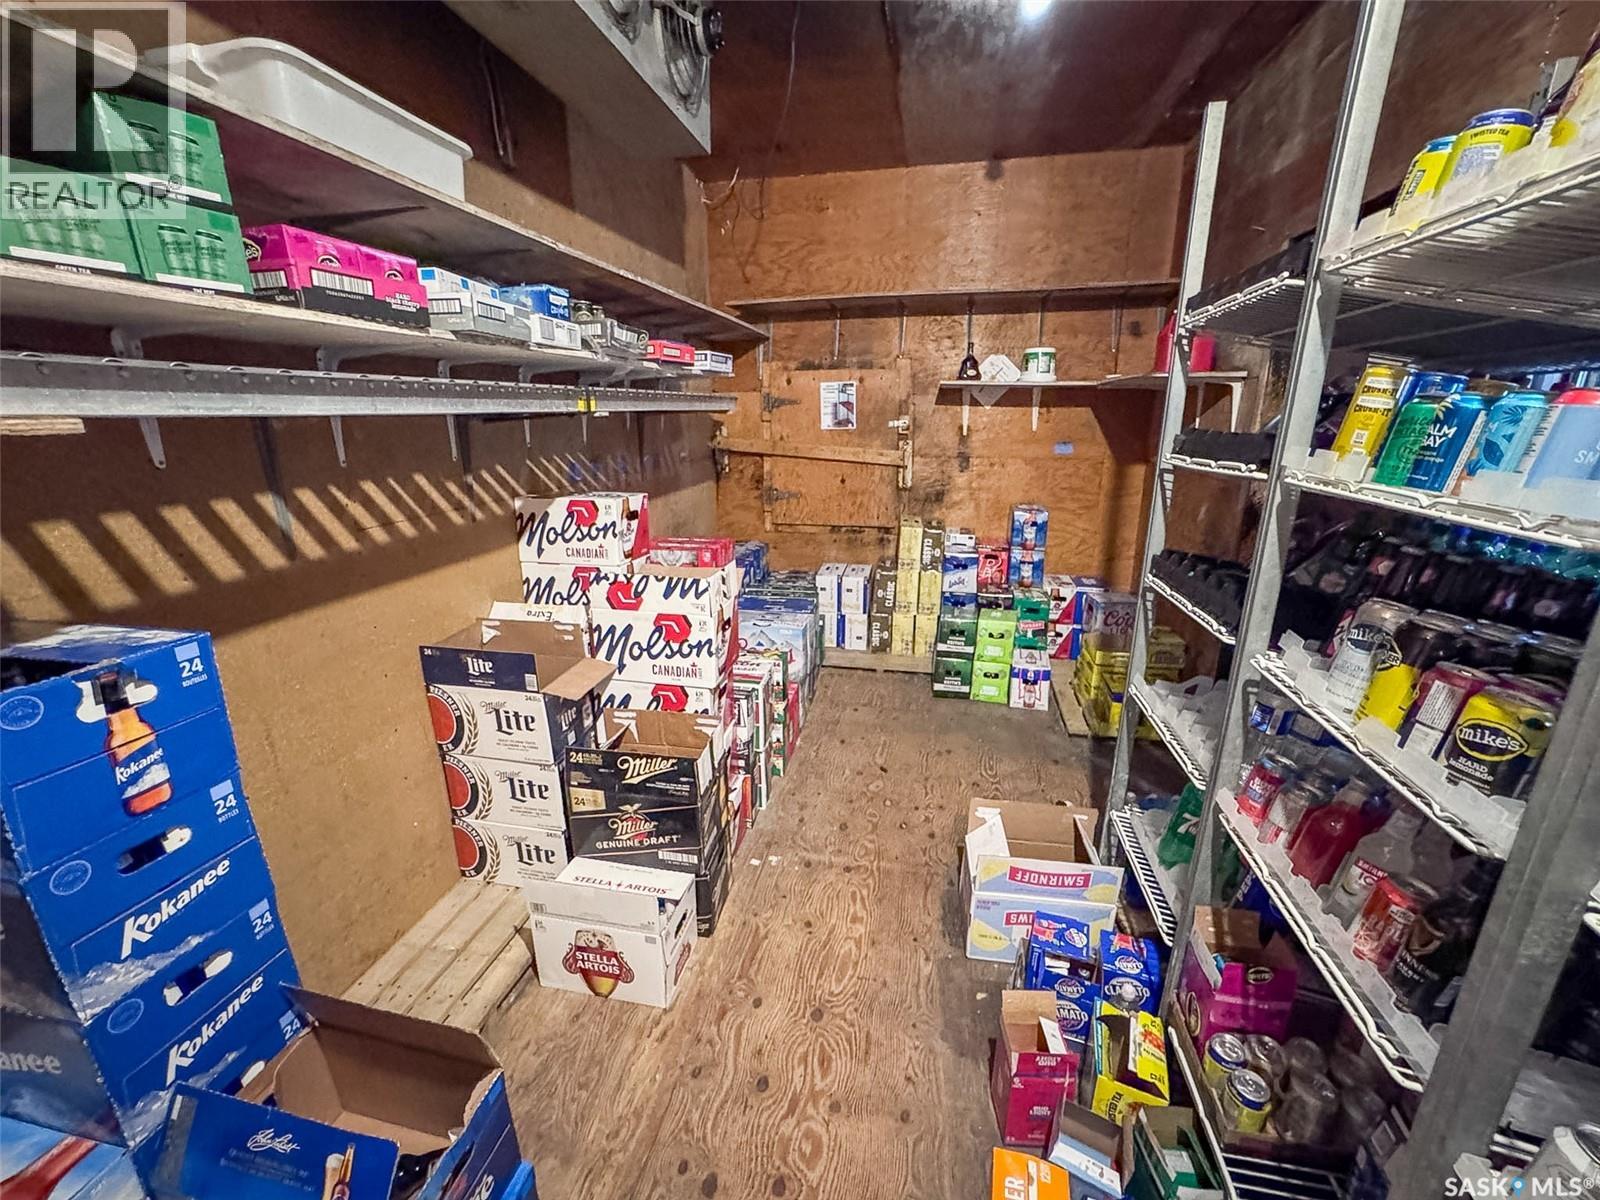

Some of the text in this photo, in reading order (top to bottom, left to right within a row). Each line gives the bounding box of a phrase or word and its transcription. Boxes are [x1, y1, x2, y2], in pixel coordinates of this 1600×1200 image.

[1427, 423, 1457, 438] ALM
[516, 510, 619, 559] Molson
[565, 547, 605, 559] CANADIAN
[523, 576, 591, 606] Mols
[594, 624, 715, 675] Molson
[179, 658, 204, 678] 24
[465, 656, 494, 676] Lite
[652, 664, 698, 679] CANADIAN
[494, 708, 536, 735] Lite
[1460, 727, 1521, 751] mike's
[115, 747, 164, 786] Kokanee
[570, 752, 583, 763] 24
[1458, 756, 1489, 773] HARD
[617, 756, 678, 784] Miller
[1448, 757, 1494, 781] lemonade
[508, 777, 549, 803] Lite
[215, 794, 237, 815] 24
[574, 796, 585, 806] 24
[608, 818, 658, 839] Miller
[595, 835, 679, 849] GENUINE DRAFT
[515, 841, 556, 867] Lite
[573, 876, 668, 895] STELLA ARTOIS
[1014, 870, 1085, 887] SMIRNOFF
[120, 857, 230, 961] Kokanee
[252, 911, 273, 934] 24
[576, 951, 619, 966] STELLA
[576, 960, 621, 974] ARTOIS
[166, 973, 264, 1088] Kokanee
[282, 1019, 302, 1041] 24
[0, 1051, 62, 1074] anee
